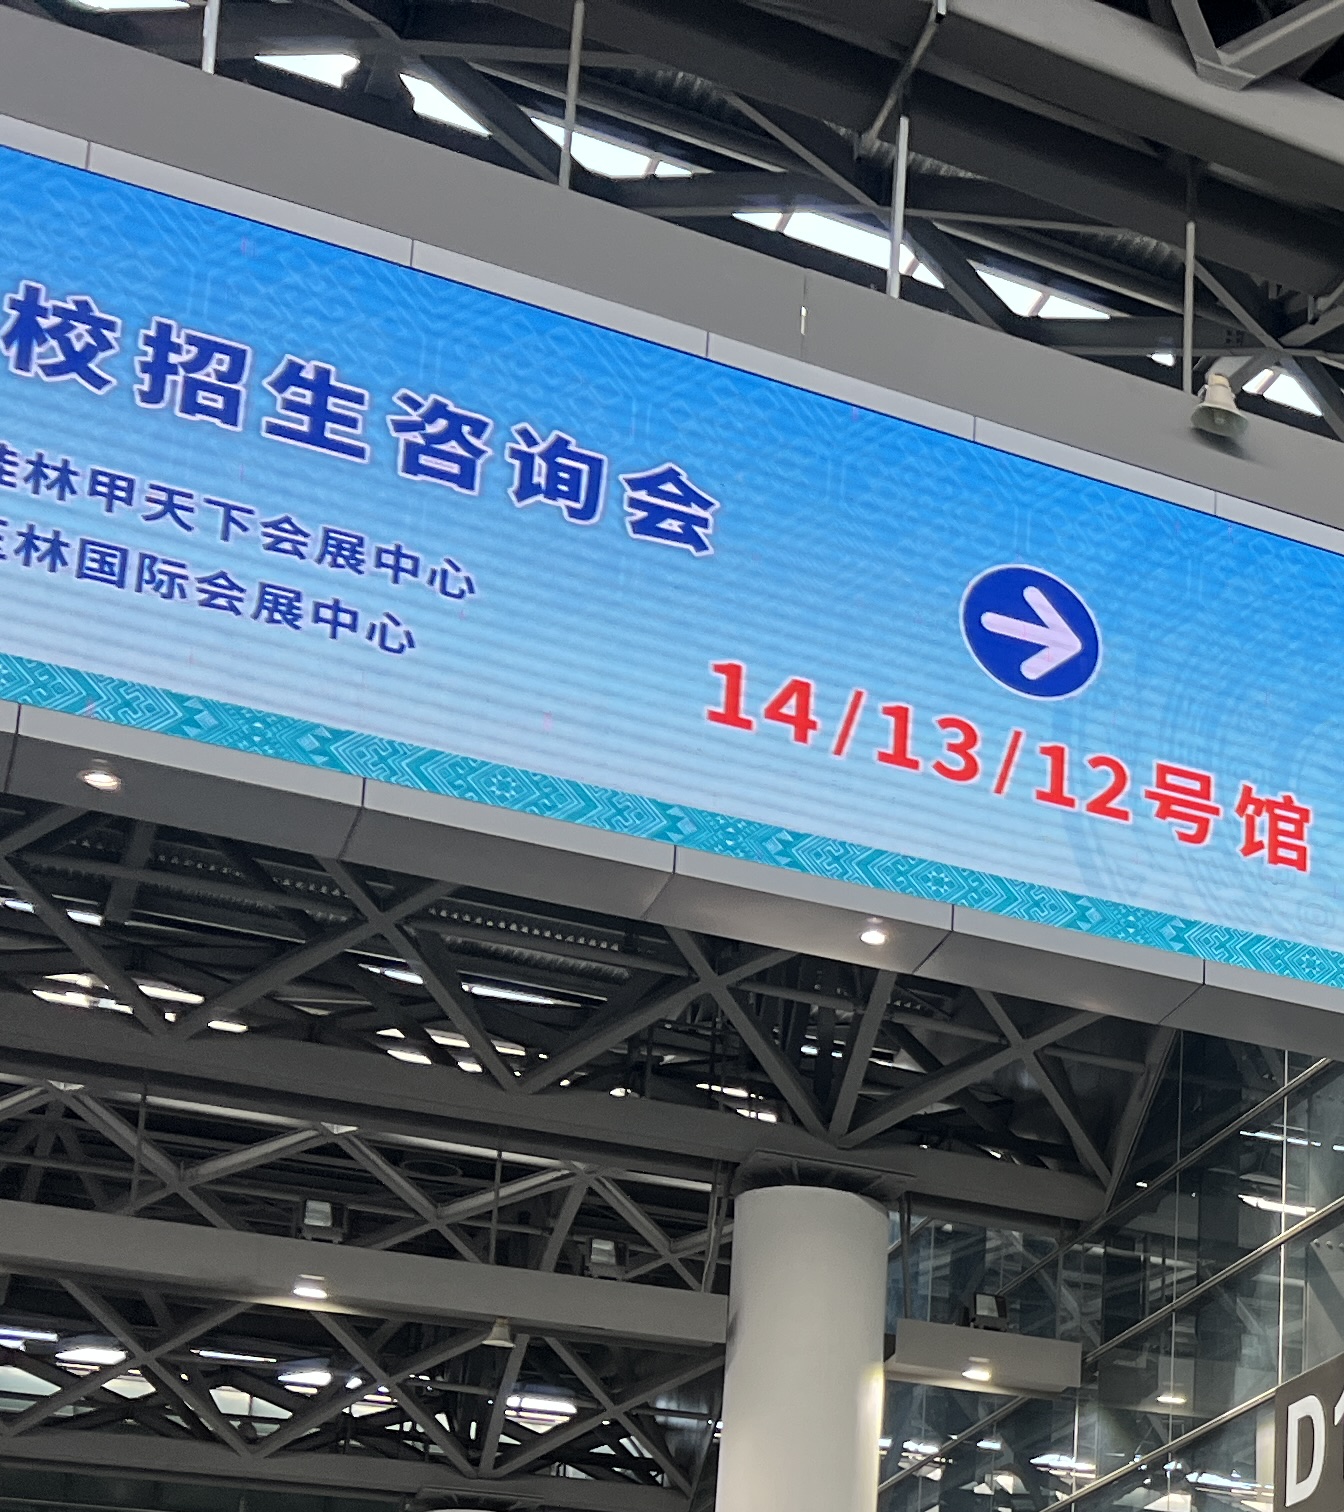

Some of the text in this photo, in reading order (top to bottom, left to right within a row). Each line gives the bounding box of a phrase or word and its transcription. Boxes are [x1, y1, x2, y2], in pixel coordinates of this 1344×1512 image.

[0, 280, 720, 557] 校招生咨询会
[0, 518, 417, 655] 林国际会展中心
[706, 661, 1312, 872] 14/13/12号馆
